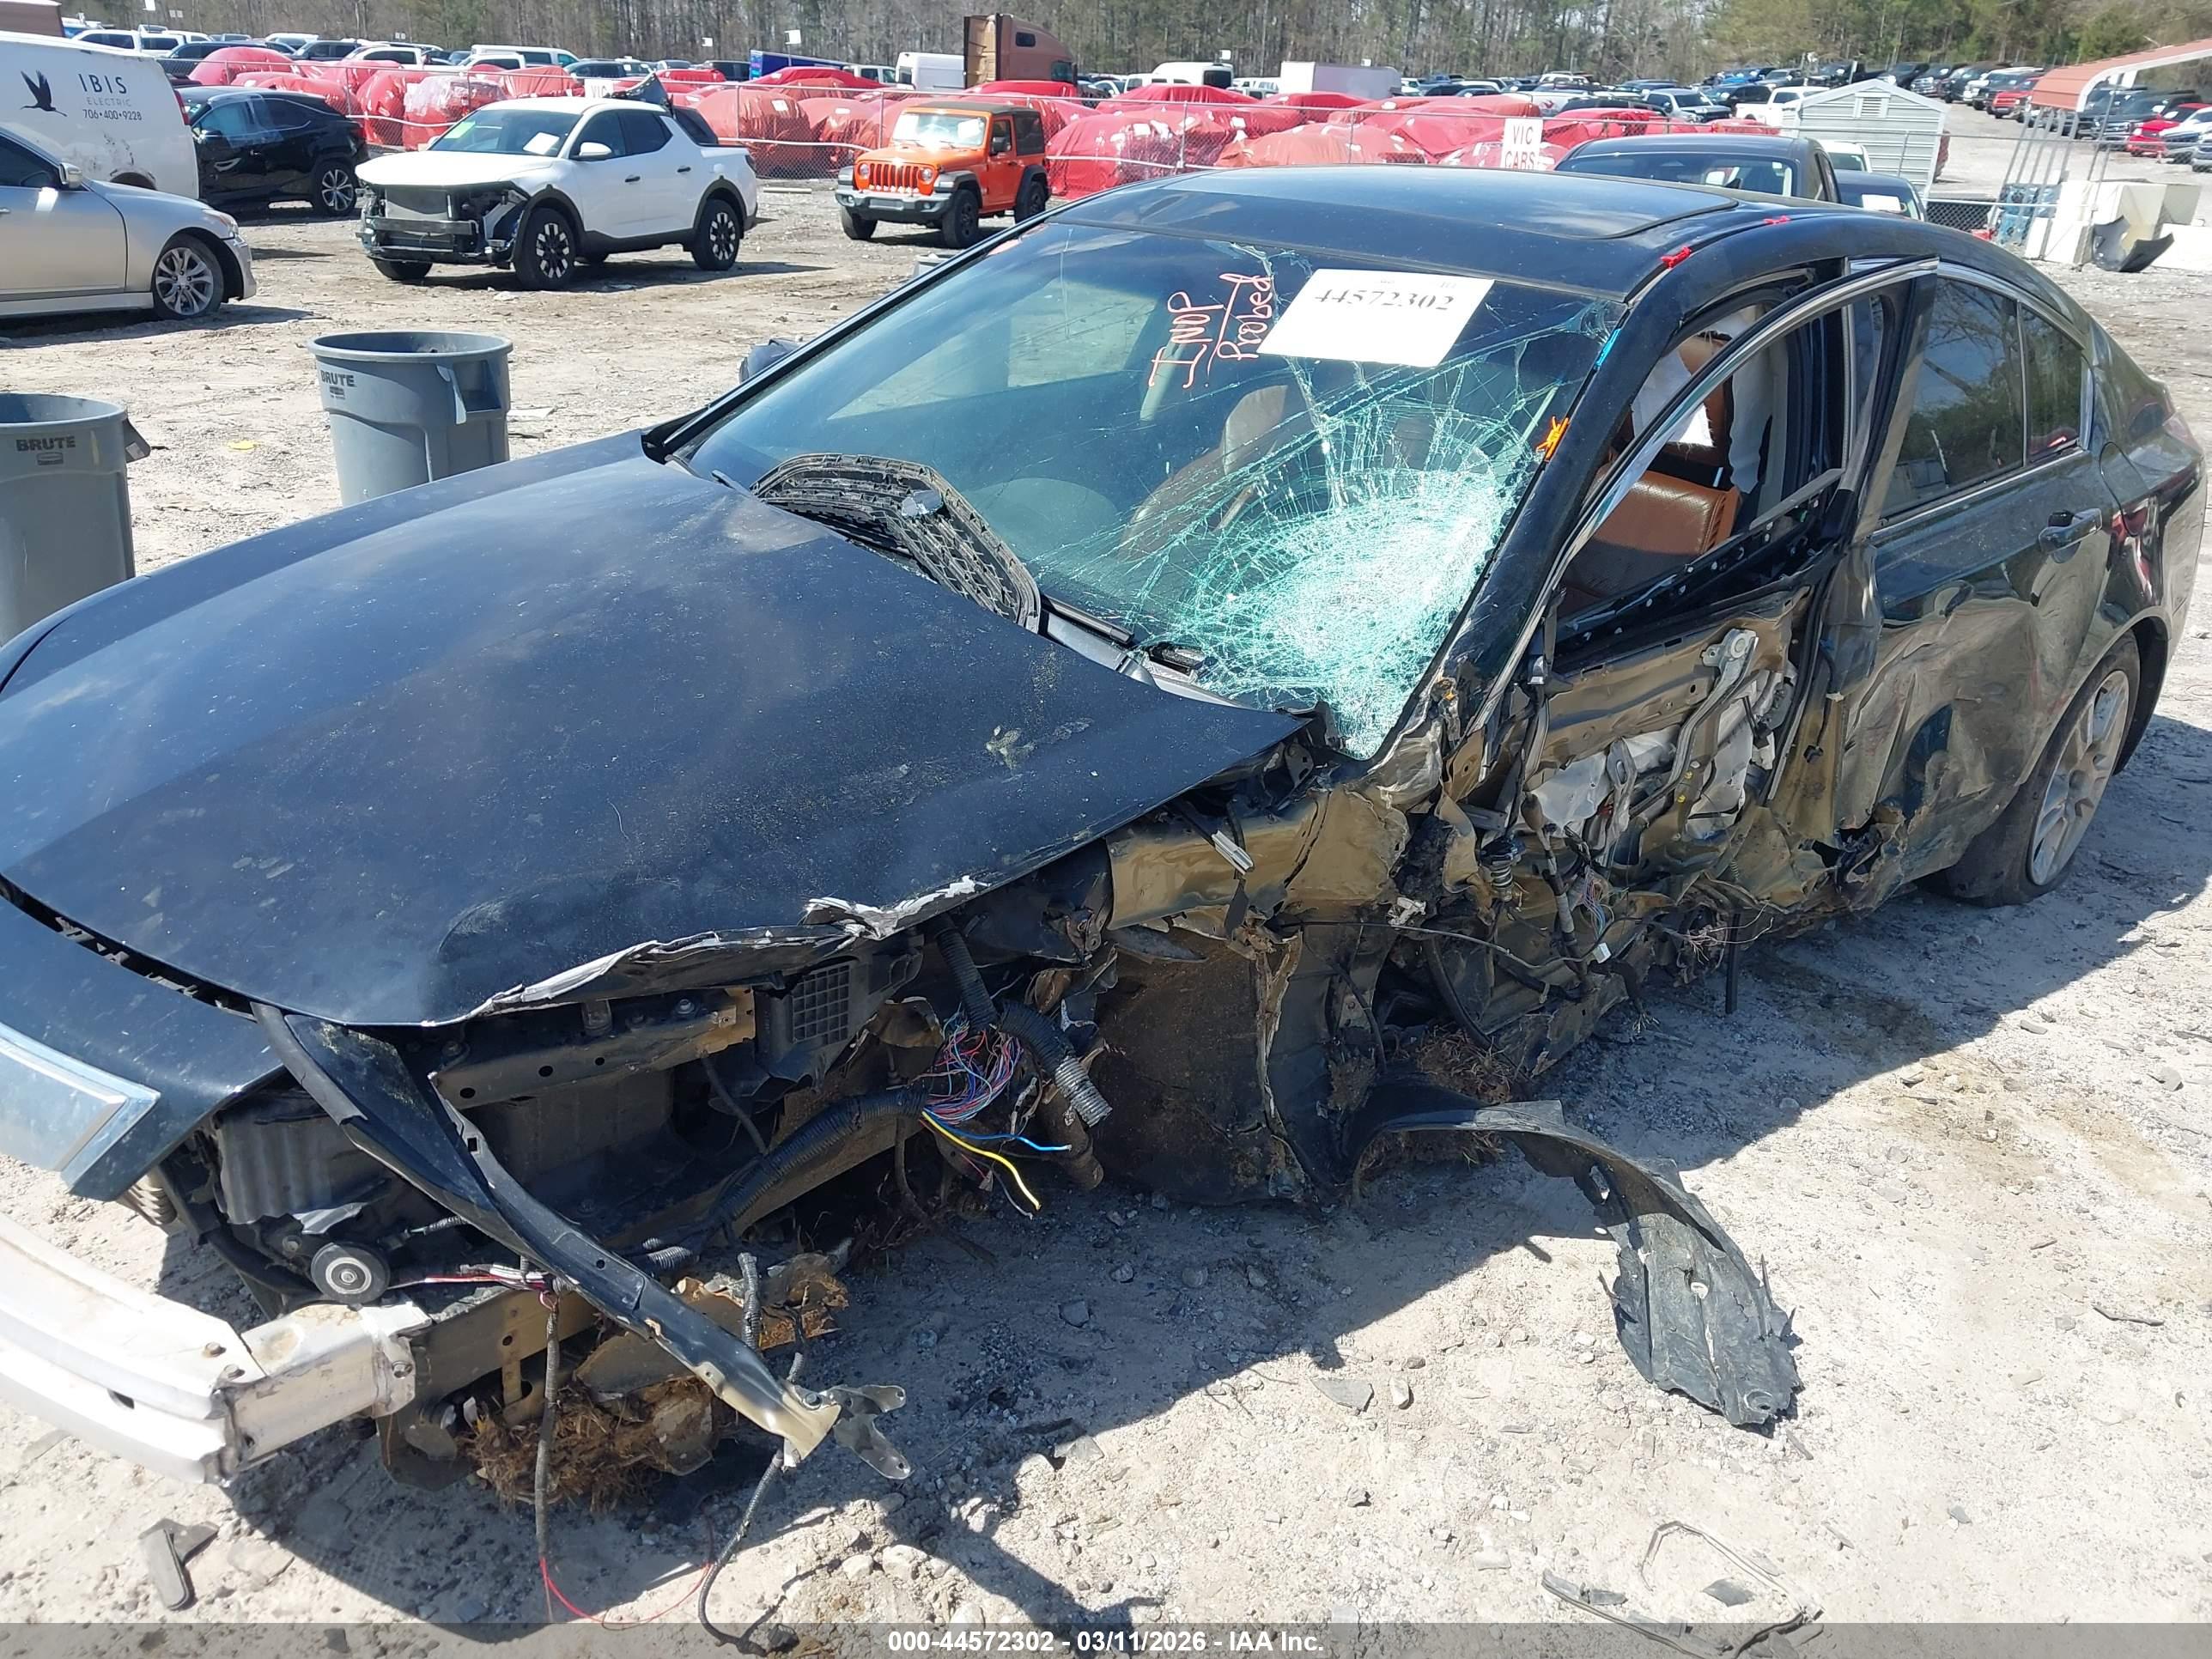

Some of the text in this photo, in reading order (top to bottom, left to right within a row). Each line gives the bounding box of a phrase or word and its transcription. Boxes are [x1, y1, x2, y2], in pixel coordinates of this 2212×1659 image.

[78, 73, 126, 94] IBIS
[88, 97, 131, 106] ELECTRIC
[1513, 125, 1533, 144] VIC
[1505, 151, 1535, 169] CARS
[1315, 289, 1454, 310] 44572302
[320, 369, 355, 386] BRUTE
[16, 436, 76, 452] BRUTE
